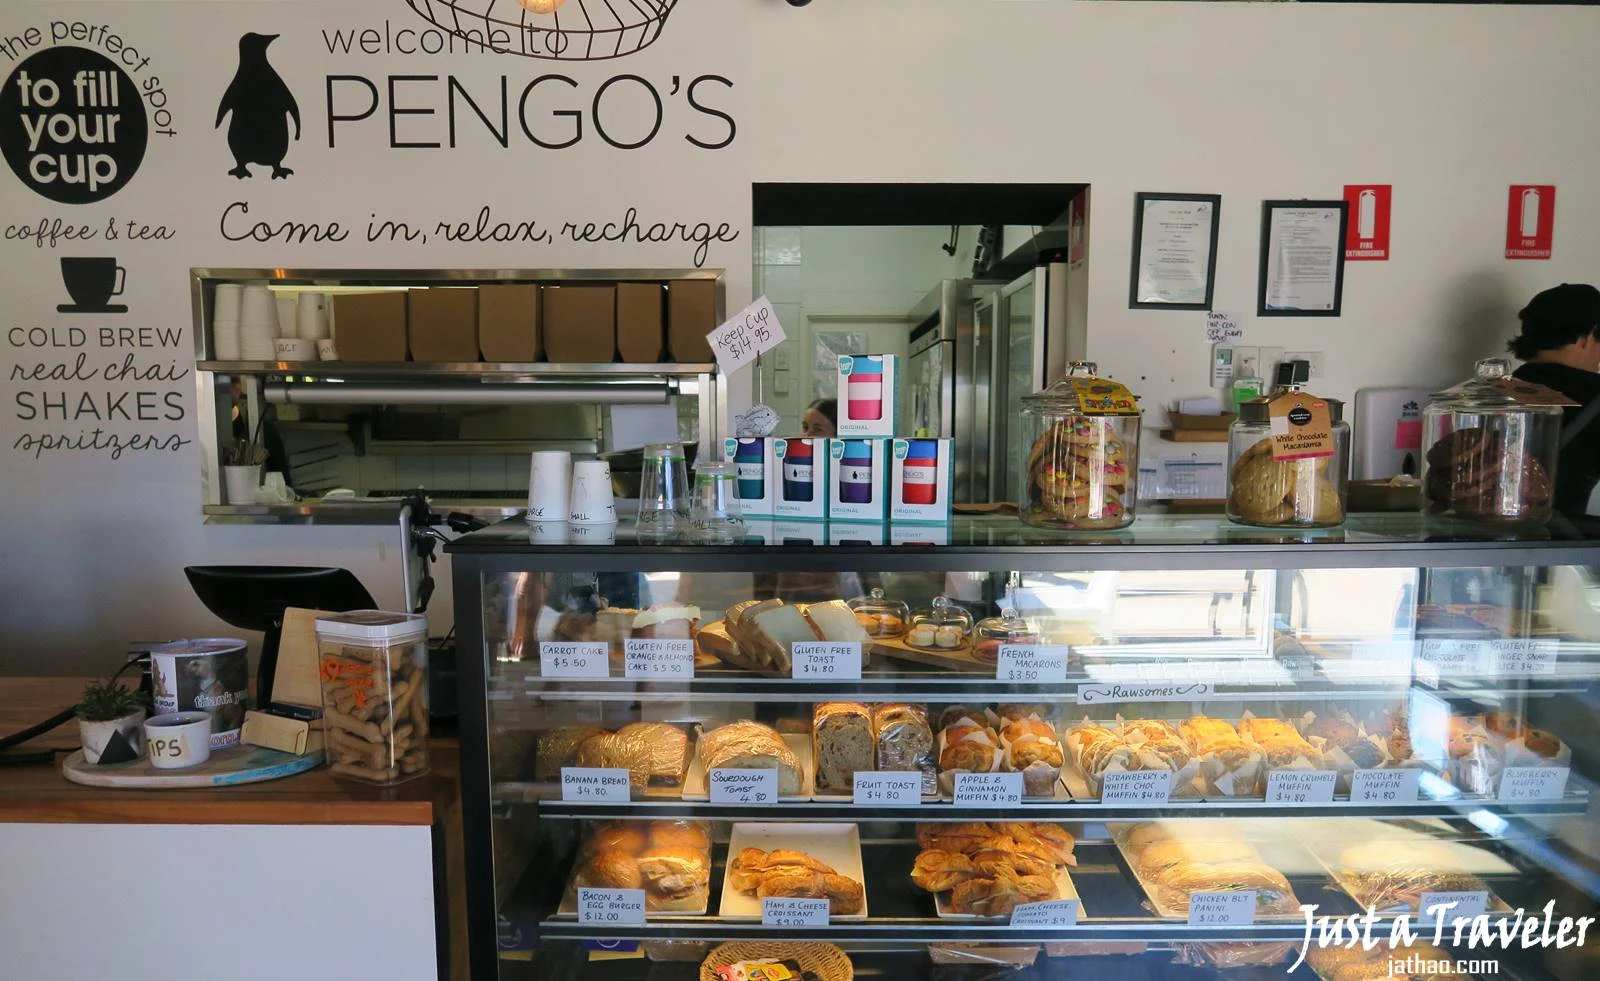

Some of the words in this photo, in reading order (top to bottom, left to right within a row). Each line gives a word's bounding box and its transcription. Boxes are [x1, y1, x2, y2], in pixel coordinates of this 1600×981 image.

[322, 20, 511, 54] welcome
[528, 22, 568, 55] to
[0, 27, 42, 62] the
[50, 20, 151, 73] perfect
[143, 76, 177, 138] spot
[17, 71, 60, 107] to
[73, 70, 119, 107] fill
[326, 74, 736, 150] PENGO'S
[20, 113, 120, 152] your
[29, 152, 118, 192] cup
[5, 218, 98, 248] coffee
[105, 217, 118, 241] &
[127, 220, 176, 240] tea
[220, 201, 350, 243] Come
[561, 207, 739, 268] recharge
[717, 325, 744, 348] Keep
[745, 307, 769, 330] Cup
[8, 327, 86, 347] COLD
[99, 327, 182, 347] BREW
[10, 352, 98, 381] real
[103, 352, 189, 381] chai
[15, 391, 185, 421] SHAKES
[1296, 432, 1329, 441] Chocolate
[13, 427, 191, 459] spritzers
[543, 645, 577, 655] CARROT
[581, 647, 603, 655] CAKE
[627, 641, 663, 651] GLUTEN
[666, 643, 687, 651] FREE
[794, 645, 827, 654] GLUTEN
[831, 646, 852, 655] FREE
[626, 653, 656, 661] ORANGE
[664, 654, 694, 662] ALMOND
[1001, 648, 1034, 659] FRENCH
[808, 655, 835, 663] TOAST
[628, 663, 648, 671] CAKE
[1015, 660, 1062, 669] MACARONS
[1112, 685, 1174, 698] Rawsomes
[148, 738, 181, 757] IPS
[564, 775, 598, 784] BANANA
[601, 776, 627, 785] BREAD
[712, 770, 764, 782] SOURDOUGH
[960, 775, 989, 784] APPLE
[1105, 772, 1157, 782] STRAWBERRY
[1269, 773, 1298, 782] LEMON
[1300, 773, 1335, 782] CRUMBLE
[1355, 772, 1404, 781] CHOCOLATE
[723, 785, 755, 793] TOAST
[856, 781, 883, 789] FRUIT
[887, 782, 915, 790] TOAST
[958, 785, 1007, 793] CINNAMON
[1104, 782, 1129, 790] WHITE
[1278, 783, 1312, 791] MUFFIN
[1364, 781, 1401, 789] MUFFIN
[956, 794, 988, 802] MUFFIN
[1106, 791, 1138, 799] MUFFIN
[582, 890, 611, 901] BACON
[1191, 894, 1229, 904] CHICKEN
[1231, 894, 1249, 903] BLT
[587, 901, 605, 910] EGG
[608, 901, 642, 911] BURGER
[765, 900, 785, 910] HAM
[798, 900, 828, 911] CHEESE
[1194, 904, 1226, 912] PANINI
[768, 911, 815, 919] CROISSANT
